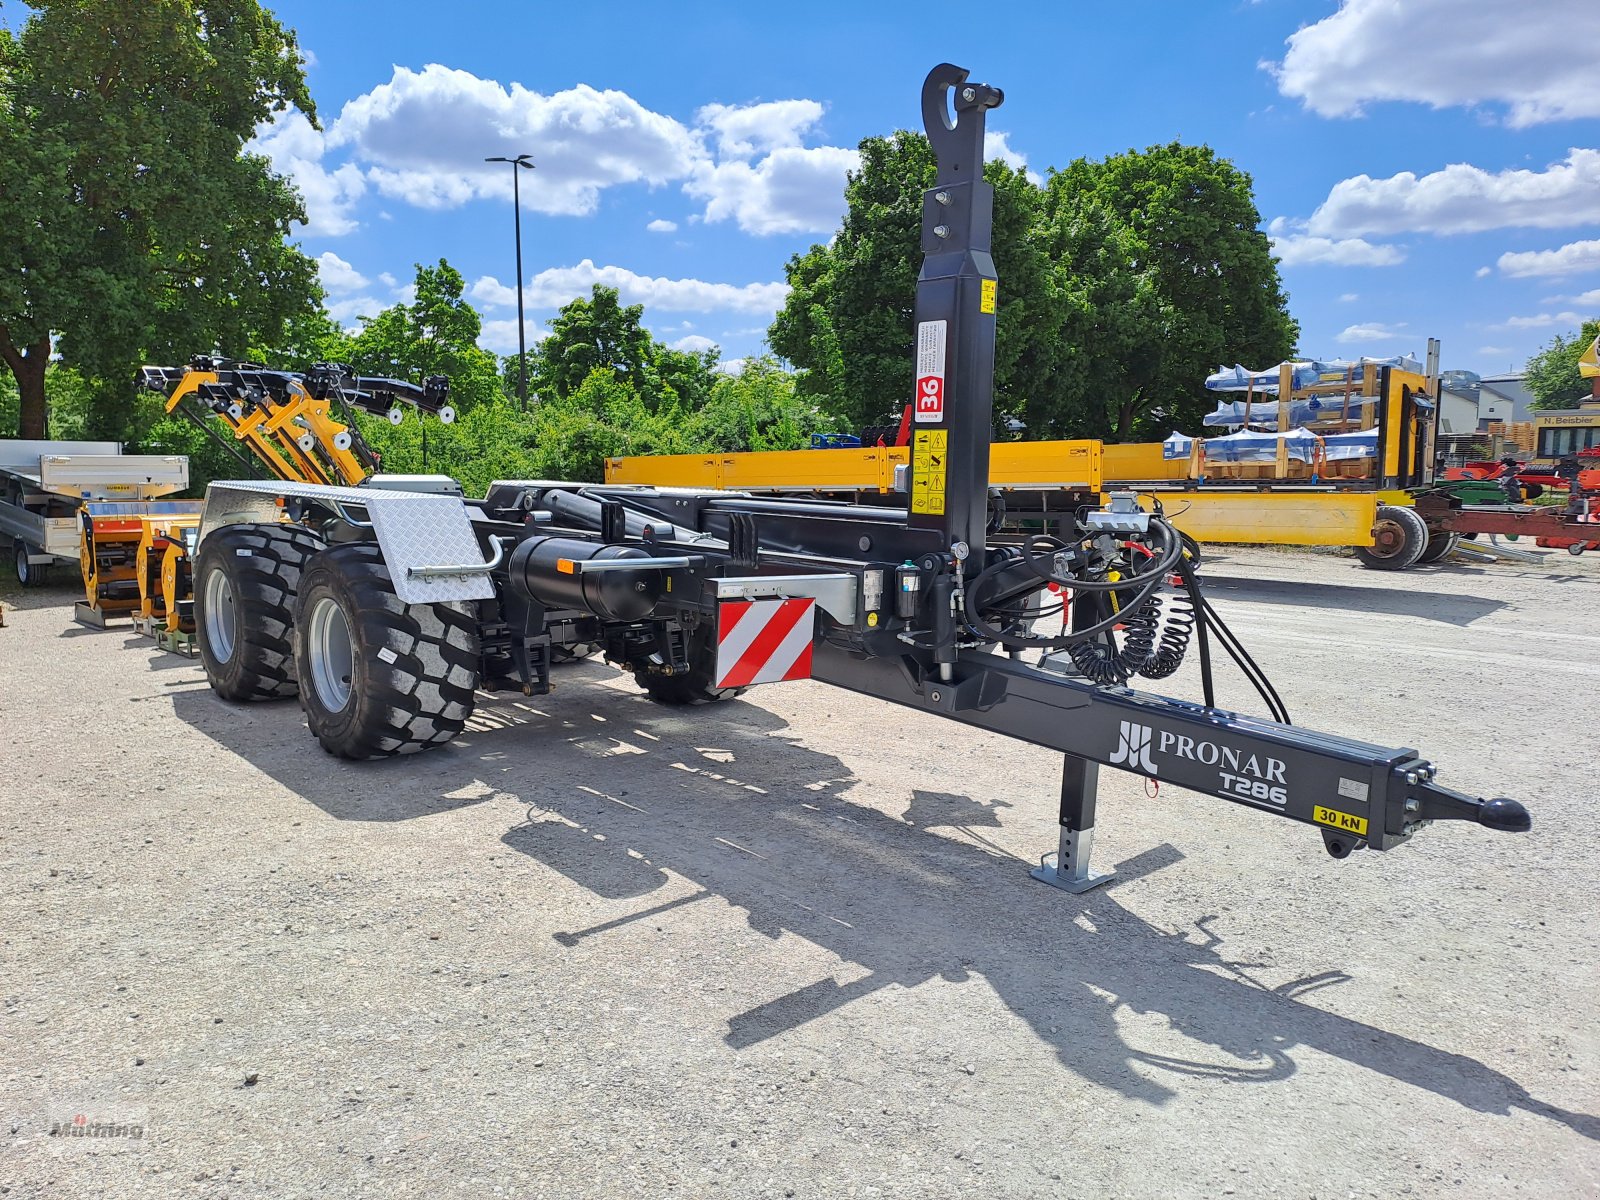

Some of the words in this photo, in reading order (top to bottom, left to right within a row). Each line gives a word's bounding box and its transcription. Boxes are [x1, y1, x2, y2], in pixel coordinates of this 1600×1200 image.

[921, 379, 939, 410] 36
[1158, 730, 1288, 785] PRONAR
[1218, 771, 1288, 805] T286
[1319, 809, 1337, 824] 30
[1340, 816, 1360, 831] kN
